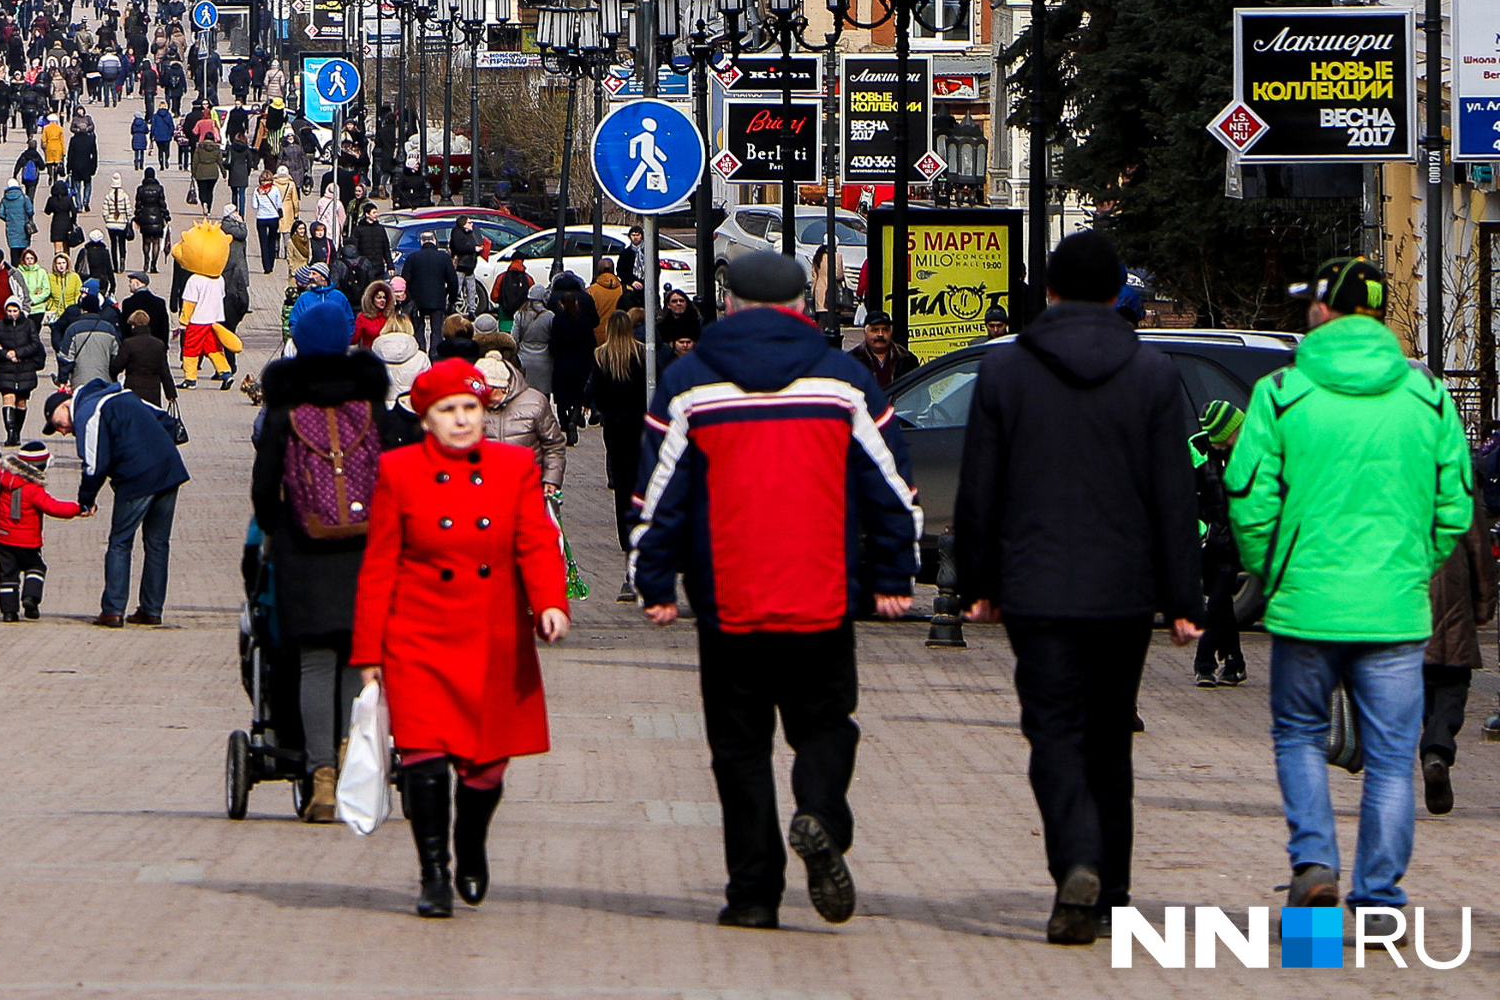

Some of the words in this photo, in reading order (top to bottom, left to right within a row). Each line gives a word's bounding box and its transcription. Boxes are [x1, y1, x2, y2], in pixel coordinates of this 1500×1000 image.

[1253, 26, 1395, 57] Лакшери
[1463, 56, 1496, 65] Школа
[1311, 61, 1394, 81] НОВЫЕ
[850, 91, 893, 102] НОВЫЕ
[1252, 81, 1394, 101] КОЛЛЕКЦИИ
[1465, 103, 1485, 113] ул.
[1232, 113, 1249, 122] LS.
[1319, 107, 1396, 127] ВЕСНА
[850, 120, 890, 131] ВЕСНА
[1229, 122, 1252, 132] NET.
[850, 130, 876, 141] 2017
[1232, 132, 1249, 142] RU
[1346, 126, 1396, 147] 2017
[746, 143, 807, 160] Berlti
[850, 155, 896, 168] 430-36-3
[924, 231, 1001, 251] МАРТА
[915, 254, 953, 267] MILO
[982, 261, 1002, 269] 19:00
